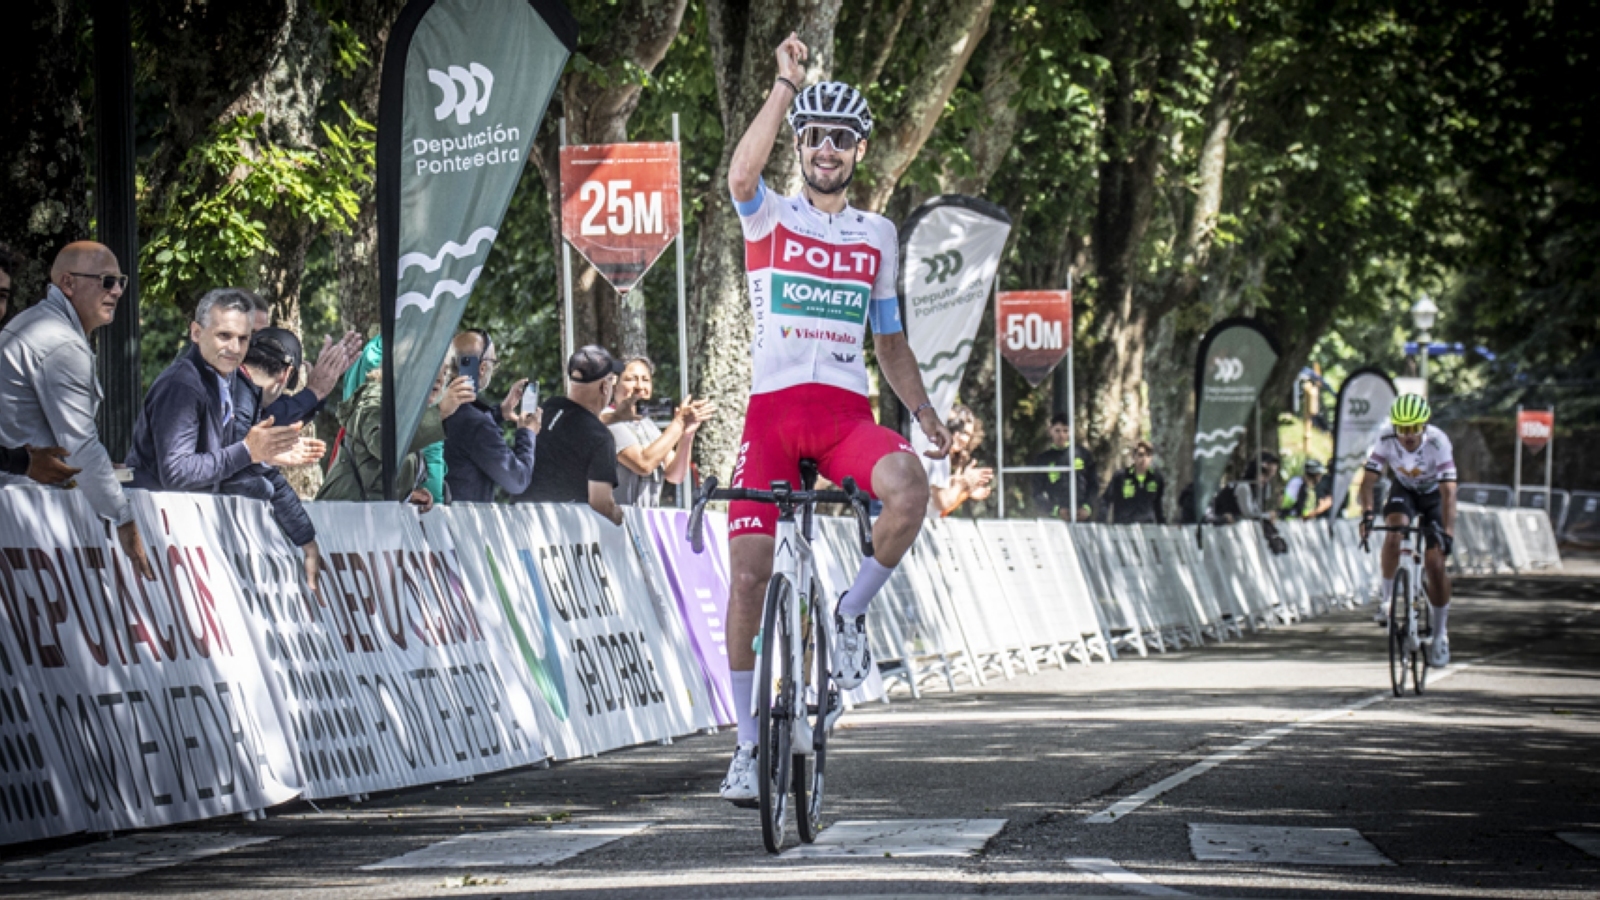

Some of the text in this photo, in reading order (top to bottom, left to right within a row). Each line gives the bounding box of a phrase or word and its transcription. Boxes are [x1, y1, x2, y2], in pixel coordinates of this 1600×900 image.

[416, 146, 520, 177] Ponteedra
[579, 179, 663, 236] 25M
[783, 238, 877, 276] POLTI
[782, 281, 863, 309] KOMETA
[1006, 313, 1063, 350] 50M
[539, 541, 621, 622] GALICIA
[572, 630, 665, 717] SAUDABLE
